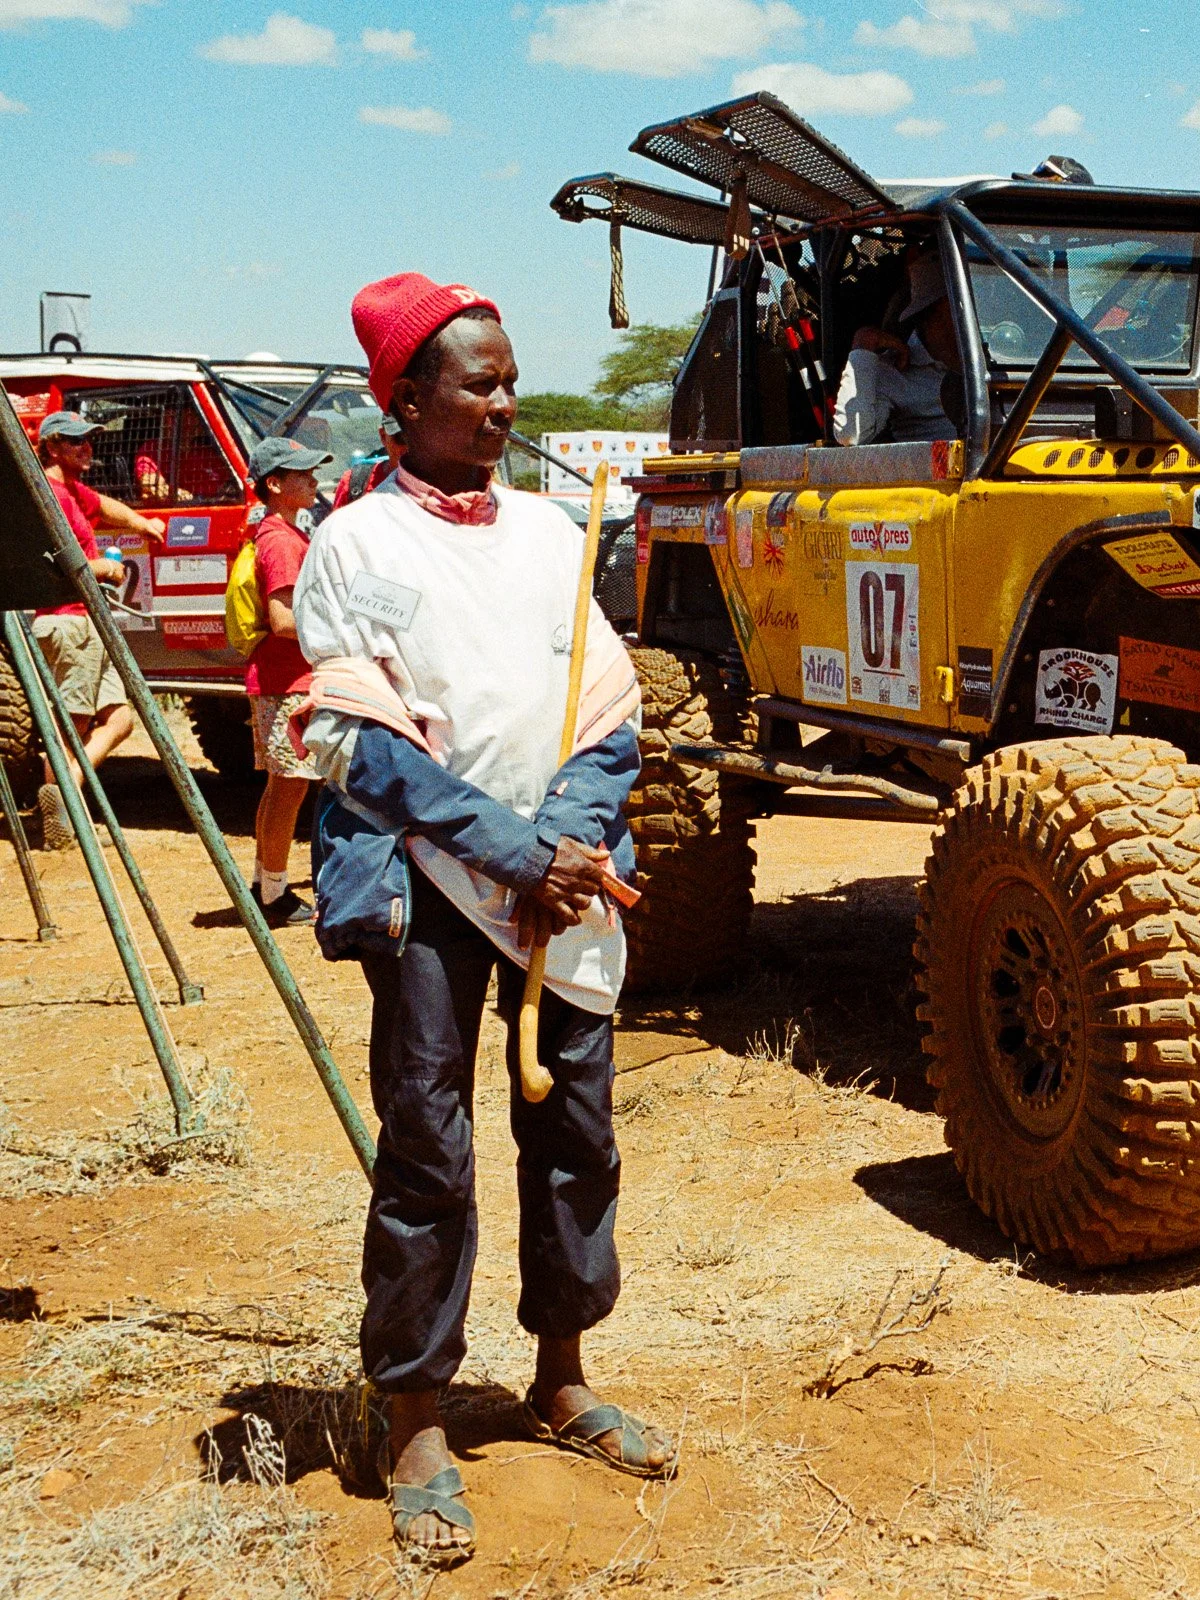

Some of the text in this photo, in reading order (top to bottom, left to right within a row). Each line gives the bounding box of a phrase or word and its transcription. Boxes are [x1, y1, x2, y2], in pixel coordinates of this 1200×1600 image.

[351, 594, 405, 618] SECURITY
[859, 570, 905, 670] 07
[1041, 650, 1115, 678] BROOKHOUSE
[1039, 707, 1108, 726] RHINO CHARGE
